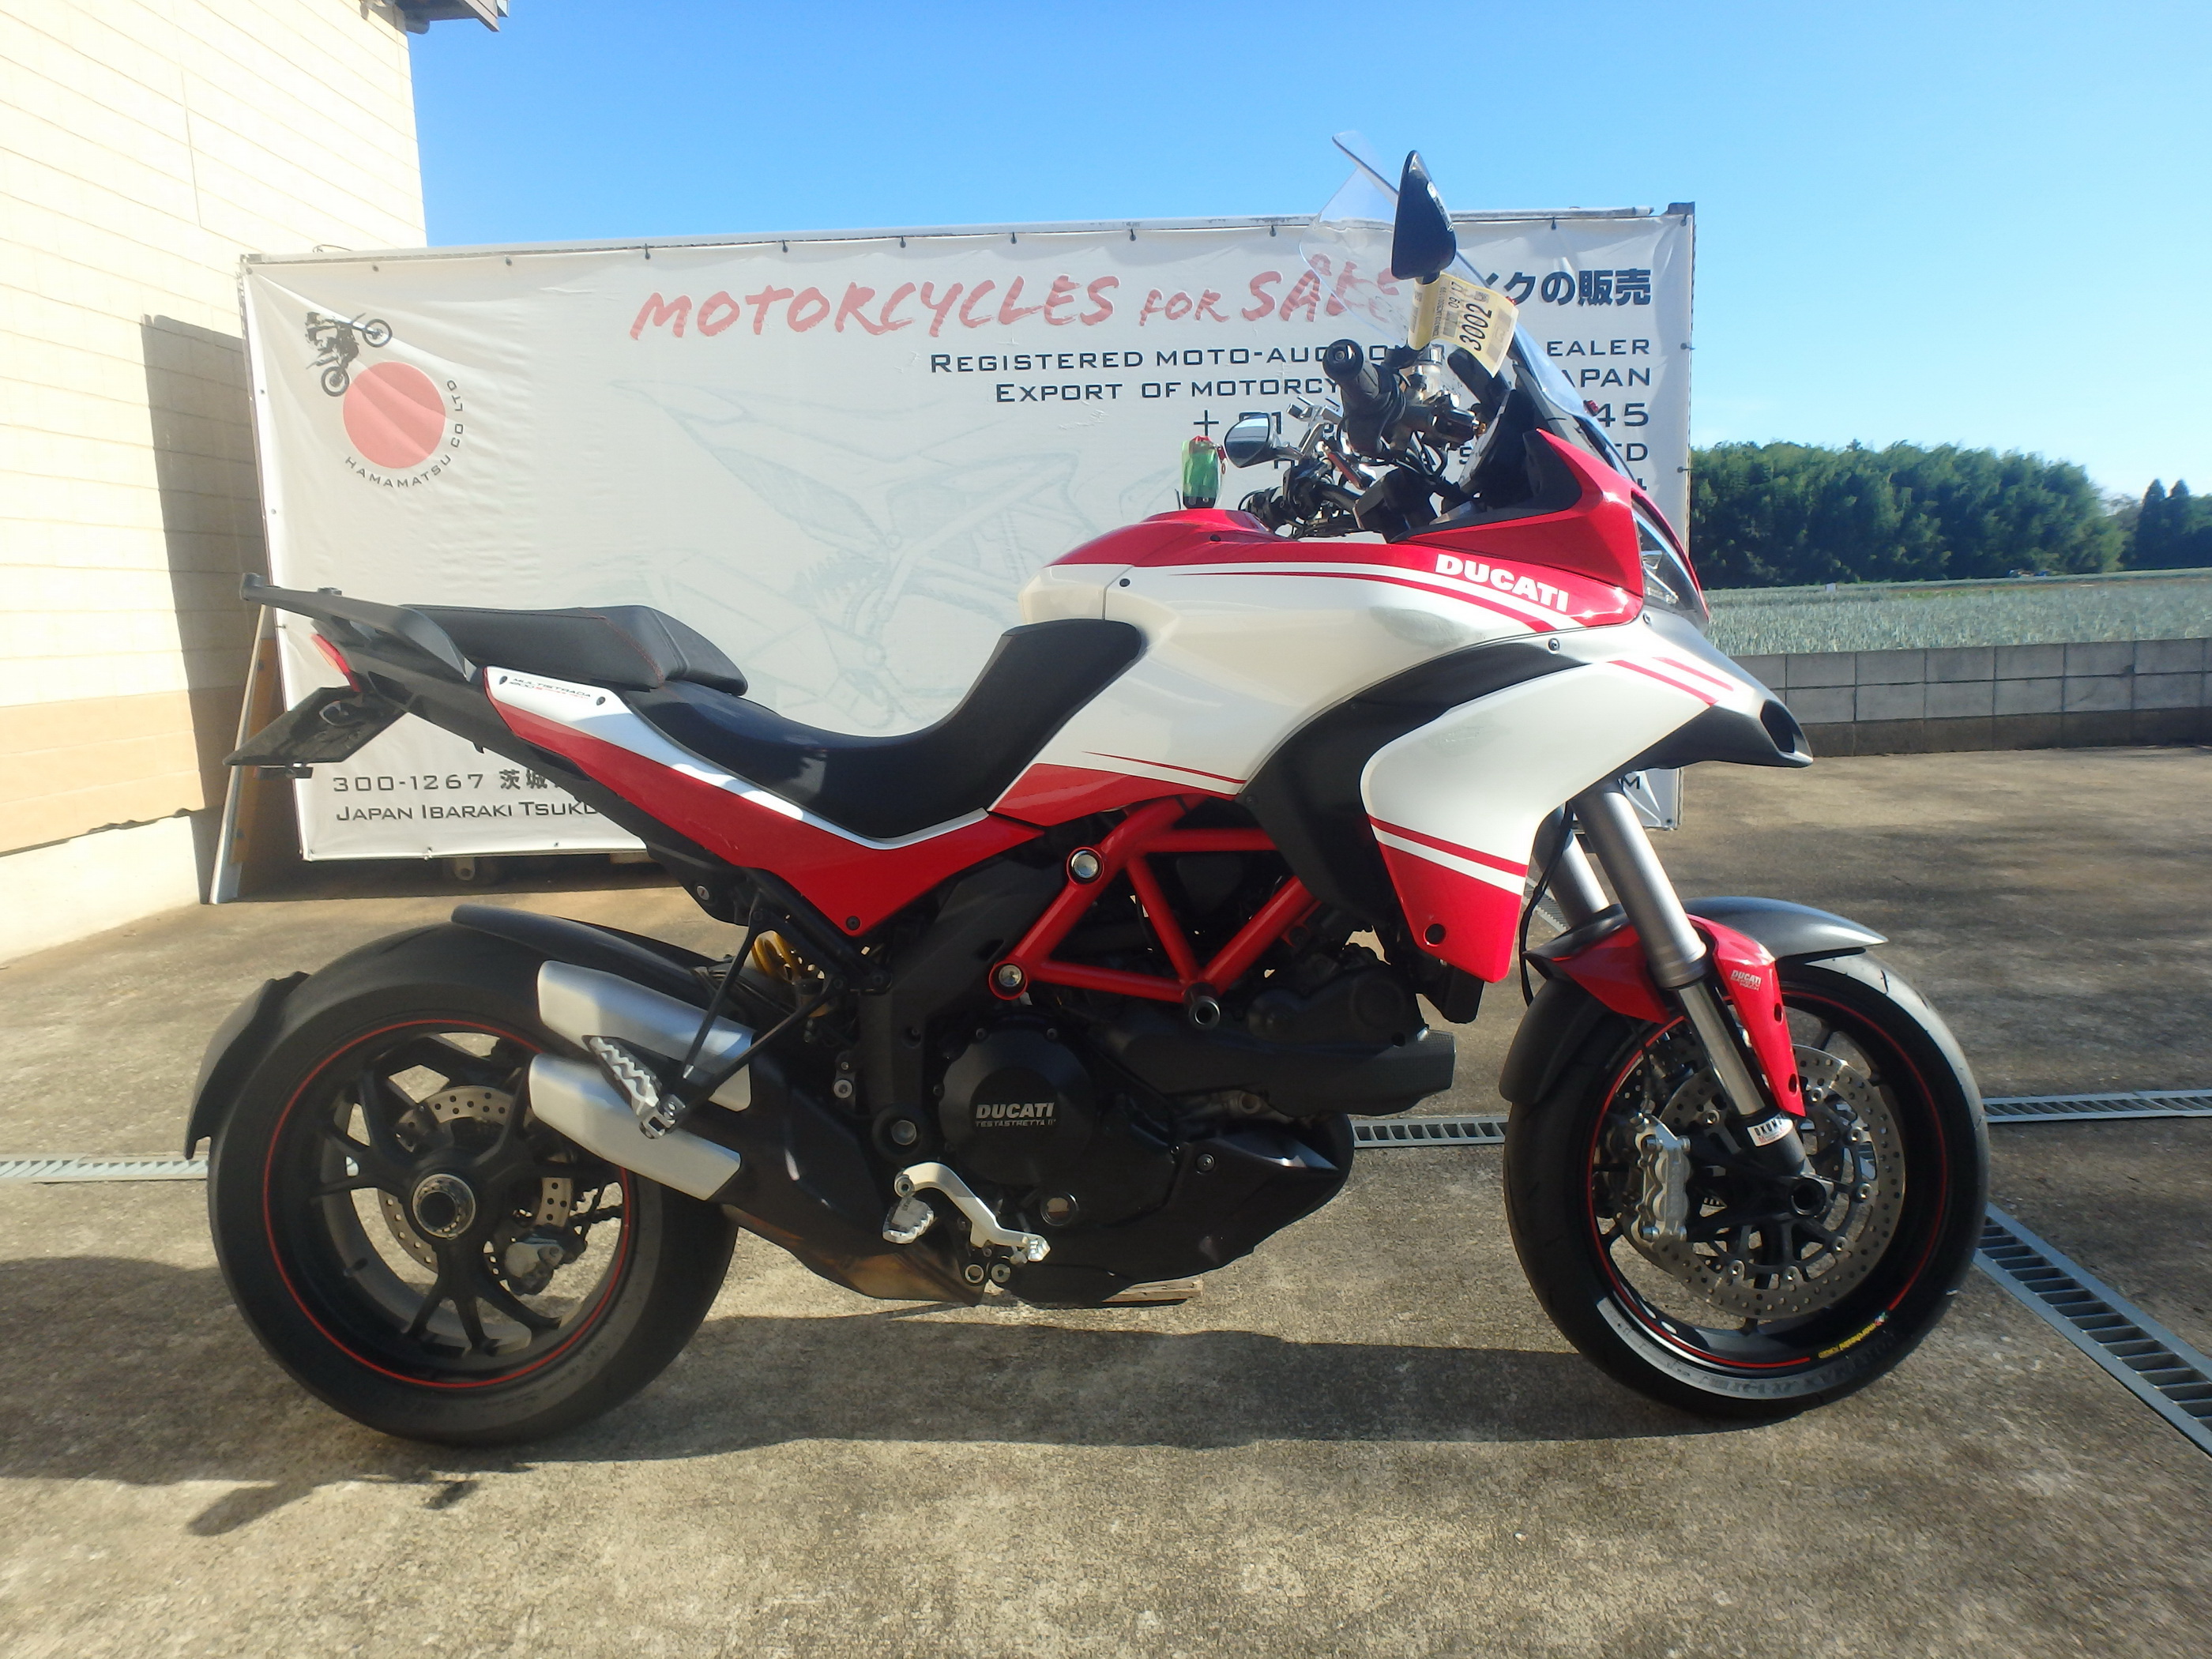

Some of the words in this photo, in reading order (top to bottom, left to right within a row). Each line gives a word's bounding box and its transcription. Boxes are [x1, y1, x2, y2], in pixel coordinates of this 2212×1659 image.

[629, 275, 1120, 340] MOTORCYCLES
[1139, 288, 1230, 326] FOR
[1459, 303, 1492, 352] 3002
[931, 351, 1143, 373] REGISTERED
[1546, 339, 1650, 357] EALER
[446, 379, 463, 412] LTD
[996, 383, 1123, 402] EXPORT
[1142, 381, 1182, 398] OF
[1191, 378, 1341, 397] MOTORCY
[450, 423, 464, 448] CO
[345, 454, 451, 487] HAMAMATSU
[1436, 554, 1568, 612] DUCATI
[333, 773, 483, 792] 300-1267
[498, 769, 558, 790] 茨城
[336, 806, 412, 821] JAPAN
[422, 803, 512, 819] IBARAKI
[1731, 969, 1762, 985] DUCATI
[976, 1102, 1055, 1119] DUCATI
